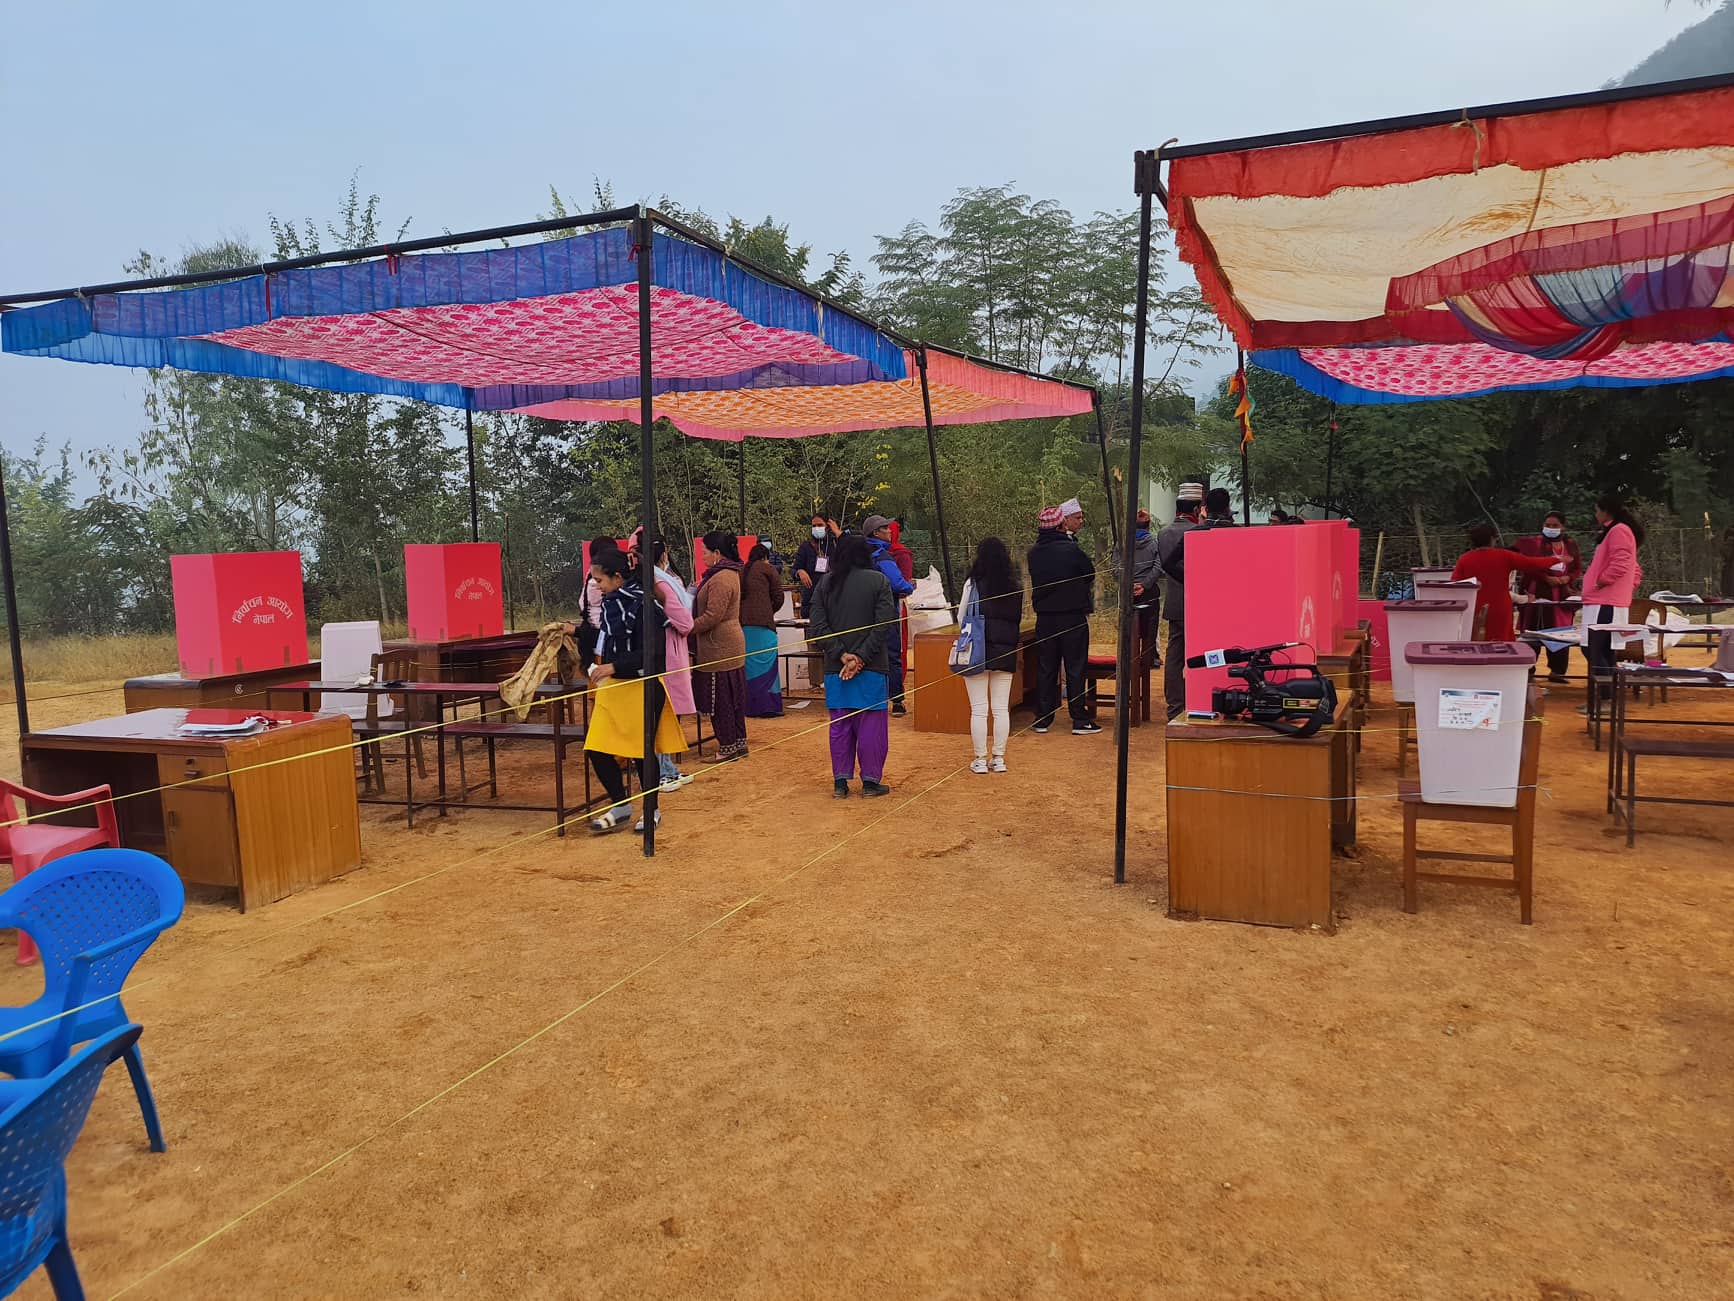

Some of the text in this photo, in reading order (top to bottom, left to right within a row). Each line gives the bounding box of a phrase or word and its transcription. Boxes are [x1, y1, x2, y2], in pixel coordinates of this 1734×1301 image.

[232, 596, 293, 624] निर्वाचन आयोग
[252, 613, 275, 624] नेपाल
